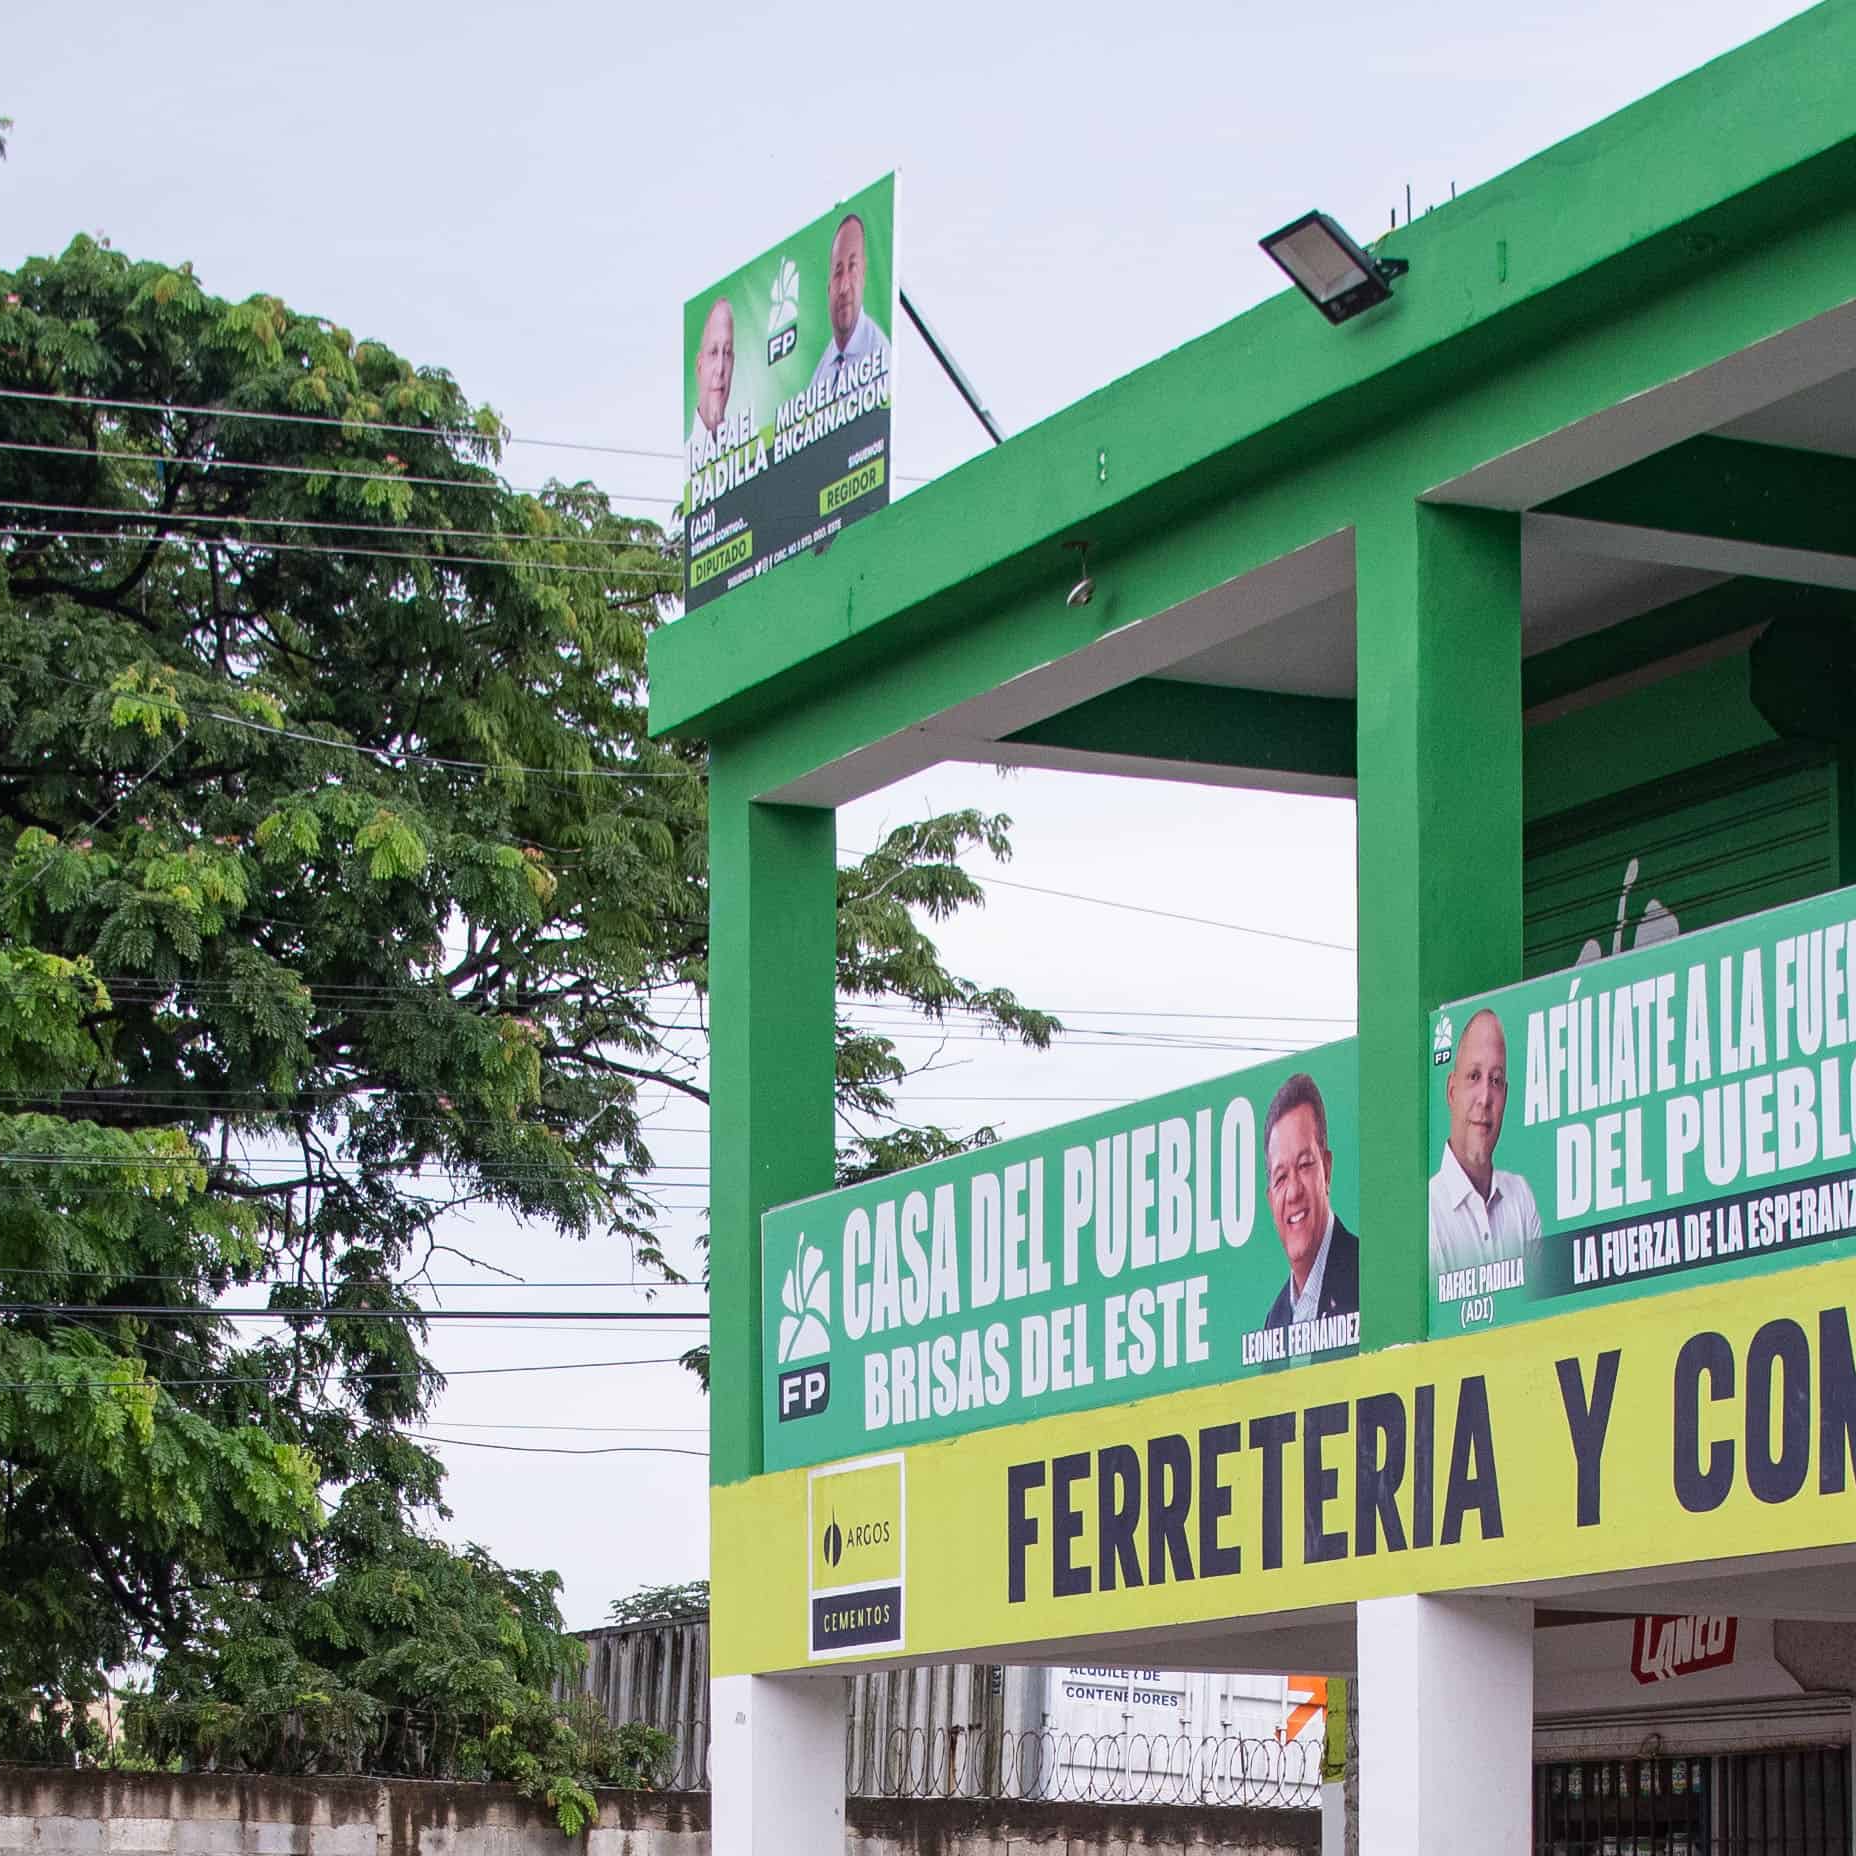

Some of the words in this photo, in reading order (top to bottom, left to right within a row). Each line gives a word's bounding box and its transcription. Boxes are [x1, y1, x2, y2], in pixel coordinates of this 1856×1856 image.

[770, 334, 796, 362] FP
[776, 379, 834, 433] MIGUEL
[836, 346, 888, 398] ÁNGEL
[690, 406, 757, 473] RAFAEL
[691, 437, 768, 512] PADILLA
[827, 468, 876, 510] REGIDOR
[691, 507, 716, 544] (ADI)
[695, 539, 746, 582] DIPUTADO
[1435, 1051, 1450, 1065] FP
[1524, 976, 1677, 1127] AFÍLIATE
[1684, 963, 1713, 1085] A
[1720, 947, 1767, 1076] LA
[1556, 1107, 1653, 1222] DEL
[842, 1184, 960, 1341] CASA
[970, 1156, 1051, 1309] DEL
[1062, 1096, 1256, 1286] PUEBLO
[1572, 1235, 1598, 1286] LA
[1601, 1213, 1681, 1277] FUERZA
[1684, 1202, 1713, 1264] DE
[1715, 1195, 1744, 1255] LA
[1438, 1264, 1479, 1304] RAFAEL
[1479, 1255, 1526, 1296] PADILLA
[1241, 1327, 1285, 1366] LEONEL
[1287, 1311, 1360, 1357] FERNÁNDEZ
[1459, 1296, 1494, 1329] (ADI)
[864, 1321, 1010, 1432] BRISAS
[1020, 1303, 1093, 1399] DEL
[1105, 1276, 1210, 1383] ESTE
[782, 1371, 827, 1416] FP
[1006, 1374, 1505, 1604] FERRETERIA
[1553, 1348, 1622, 1528] Y
[847, 1521, 890, 1548] ARGOS
[824, 1605, 890, 1632] CEMENTOS
[1640, 1615, 1726, 1681] LANCO
[1065, 1687, 1178, 1707] CONTENEDORES
